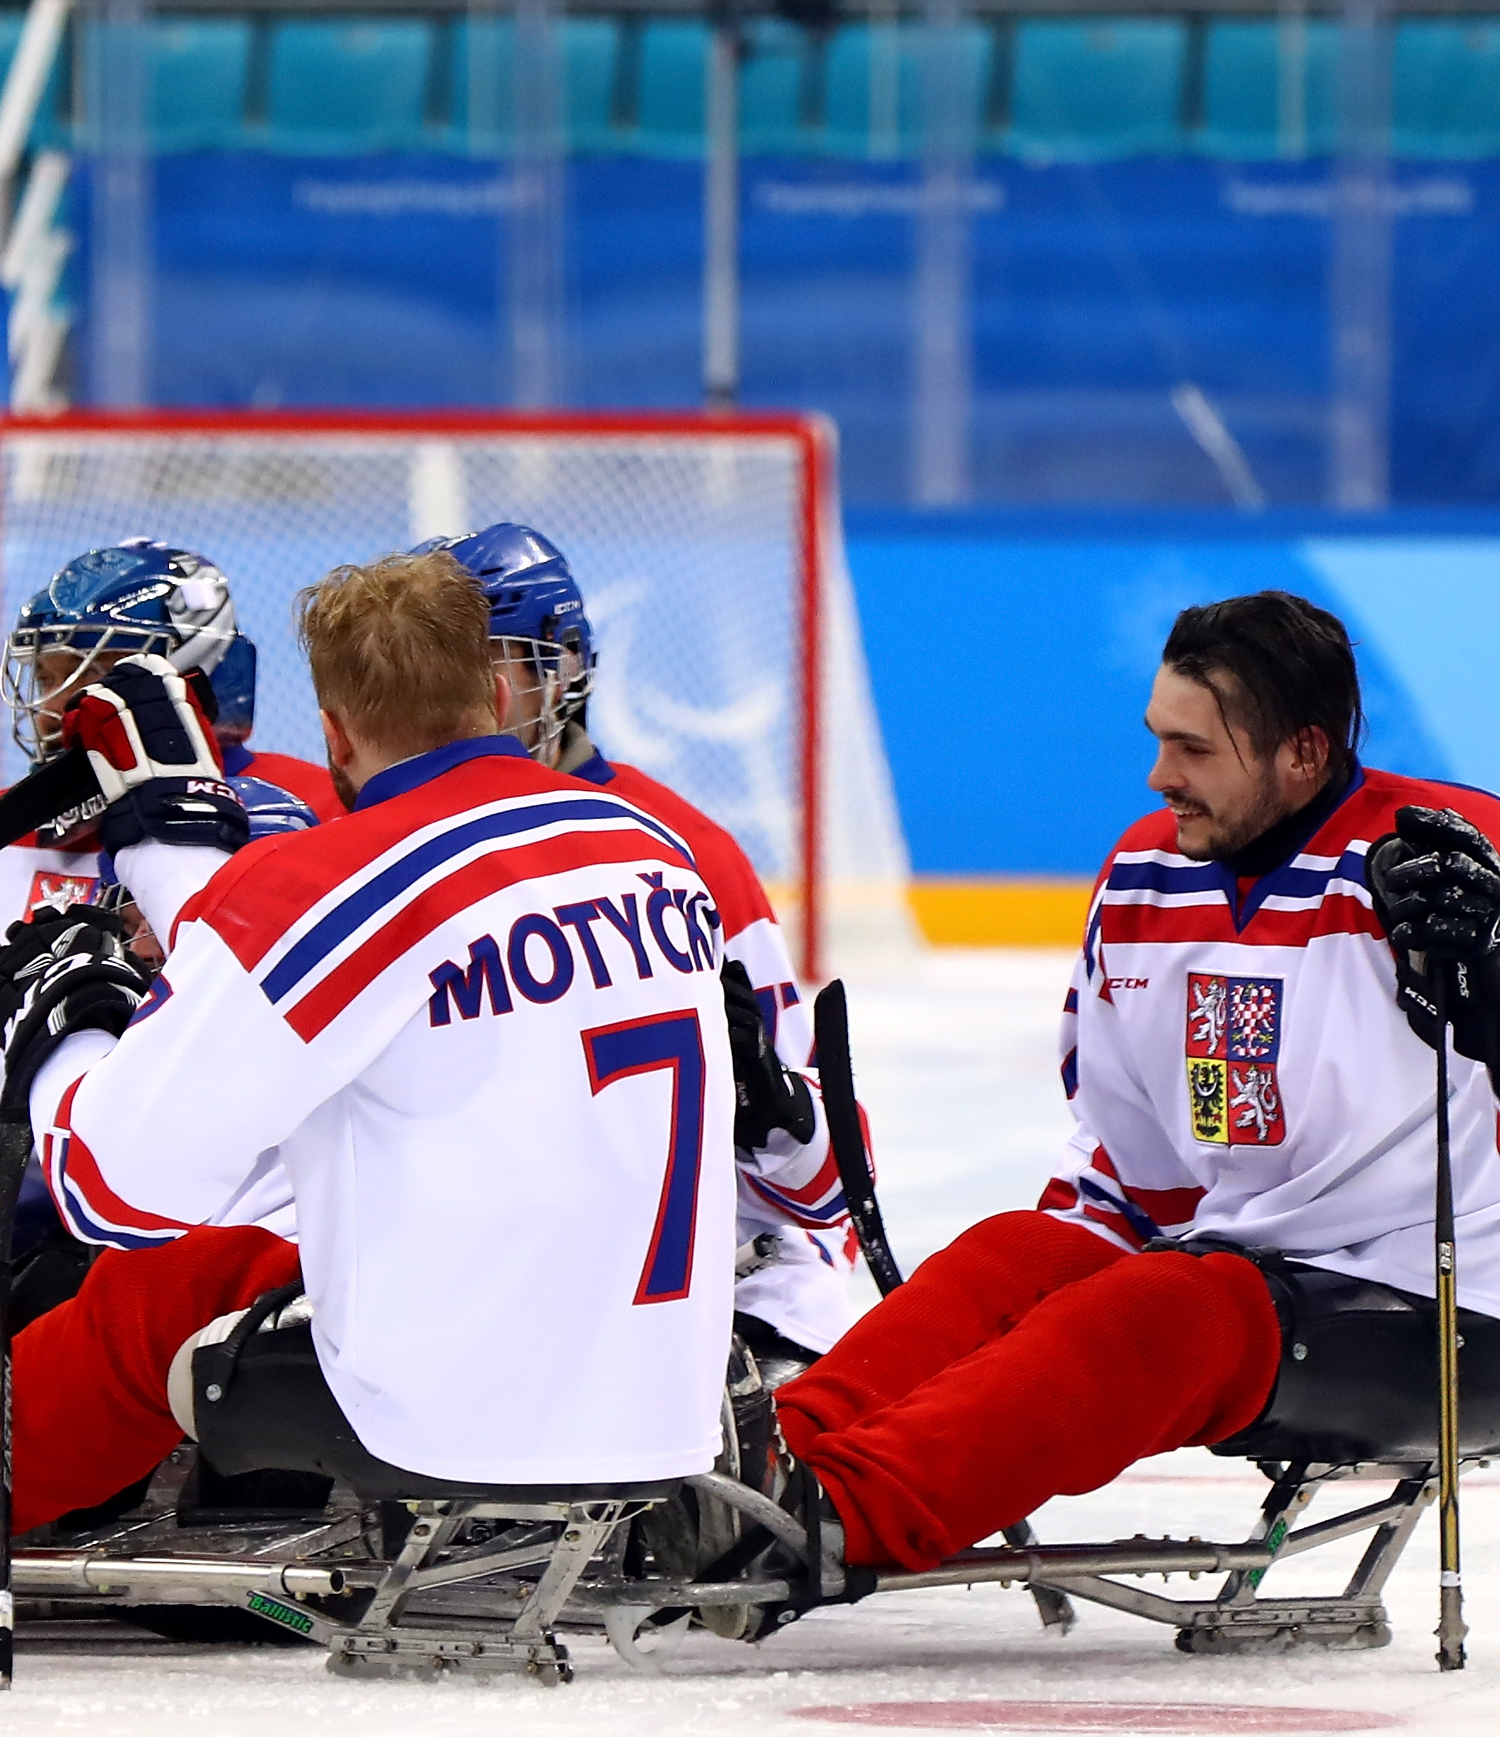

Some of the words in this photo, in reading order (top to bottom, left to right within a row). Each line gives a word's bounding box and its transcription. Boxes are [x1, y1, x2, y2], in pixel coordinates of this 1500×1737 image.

[1108, 978, 1149, 989] CCM
[580, 1007, 707, 1305] 7
[247, 1594, 313, 1634] Ballistic
